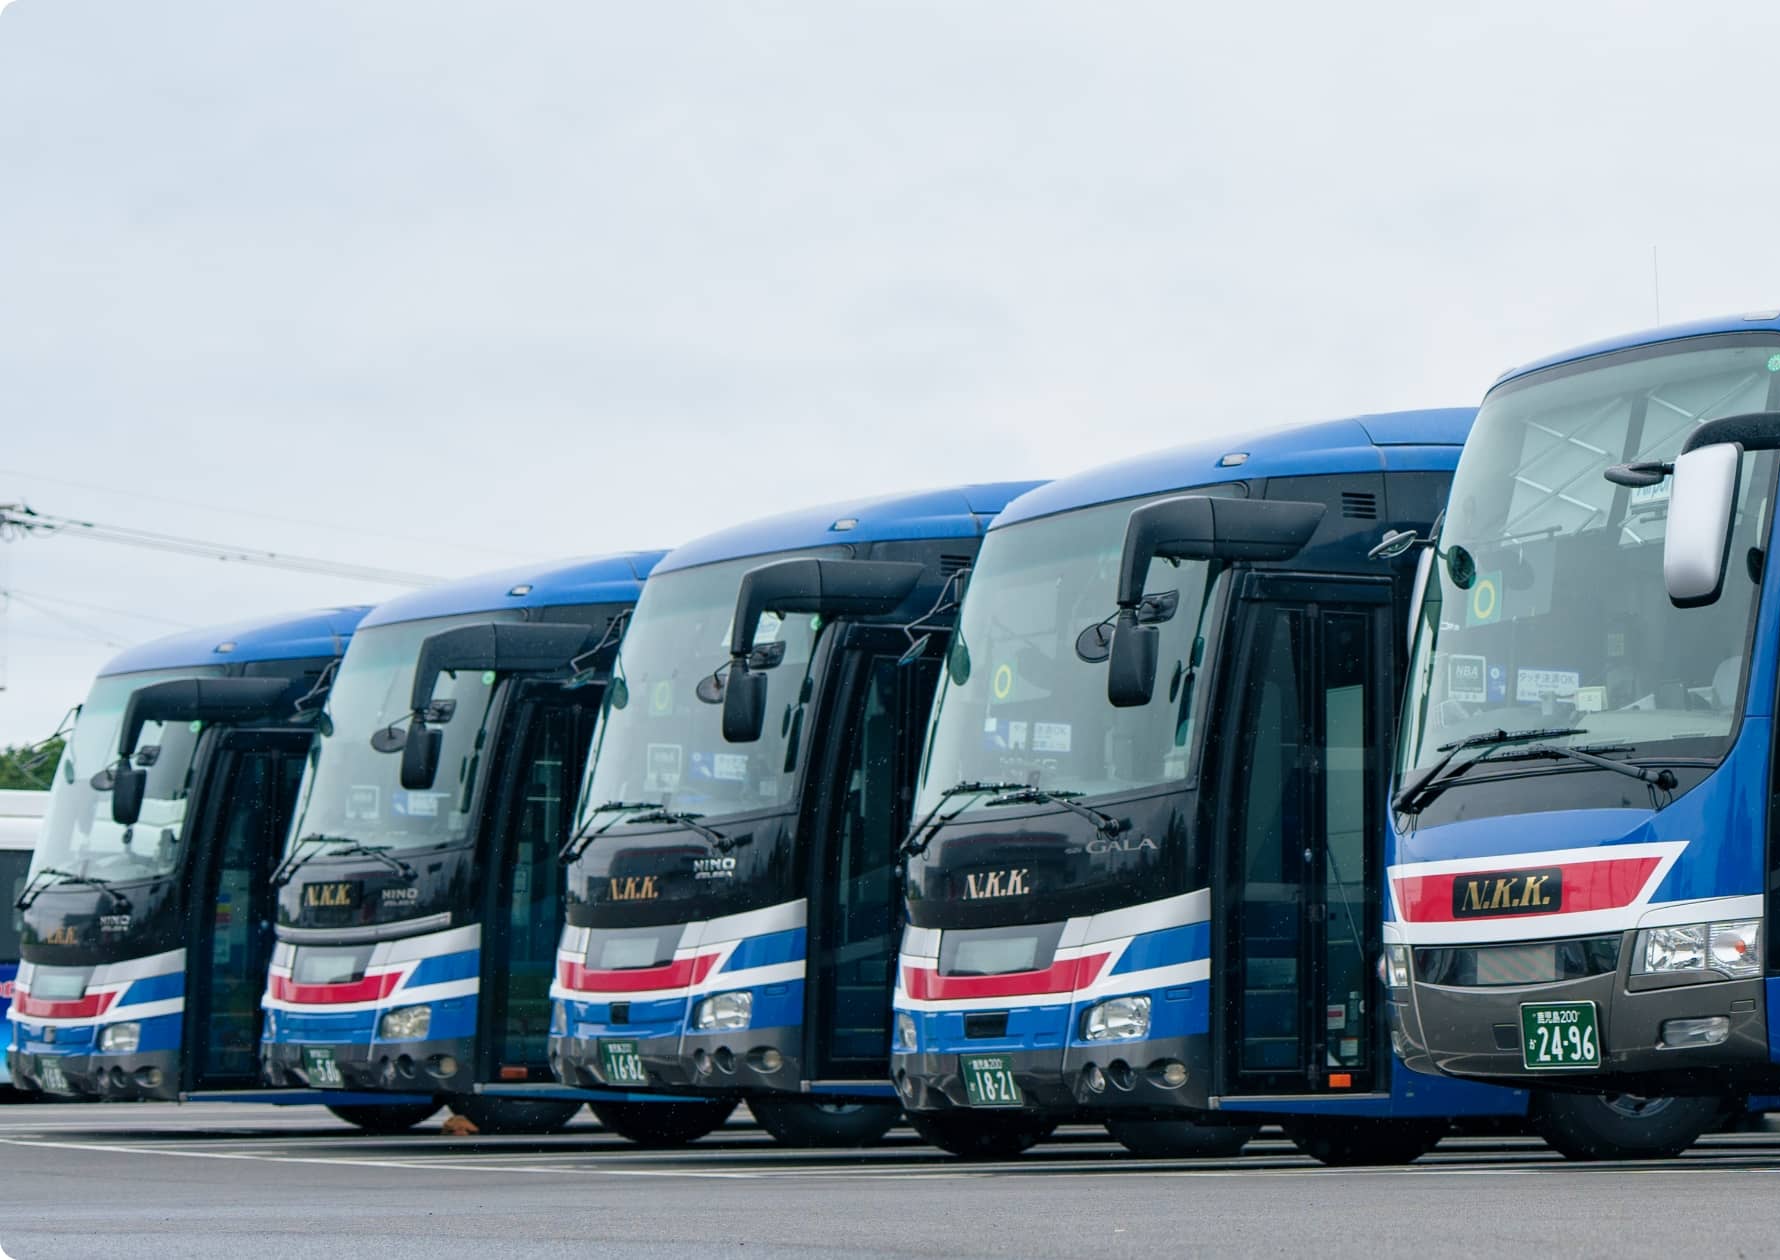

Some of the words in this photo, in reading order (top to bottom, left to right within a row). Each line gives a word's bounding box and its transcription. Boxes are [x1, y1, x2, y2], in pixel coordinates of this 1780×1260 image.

[1456, 665, 1480, 679] NBA
[1086, 837, 1159, 855] GALA
[693, 857, 736, 872] HINO
[303, 883, 352, 907] N.K.K.
[382, 887, 418, 900] HINO
[606, 875, 658, 901] N.K.K.
[963, 868, 1031, 900] N.K.K.
[1461, 875, 1550, 911] N.K.K.
[1537, 1025, 1595, 1061] 24-96
[975, 1070, 1017, 1101] 18-21
